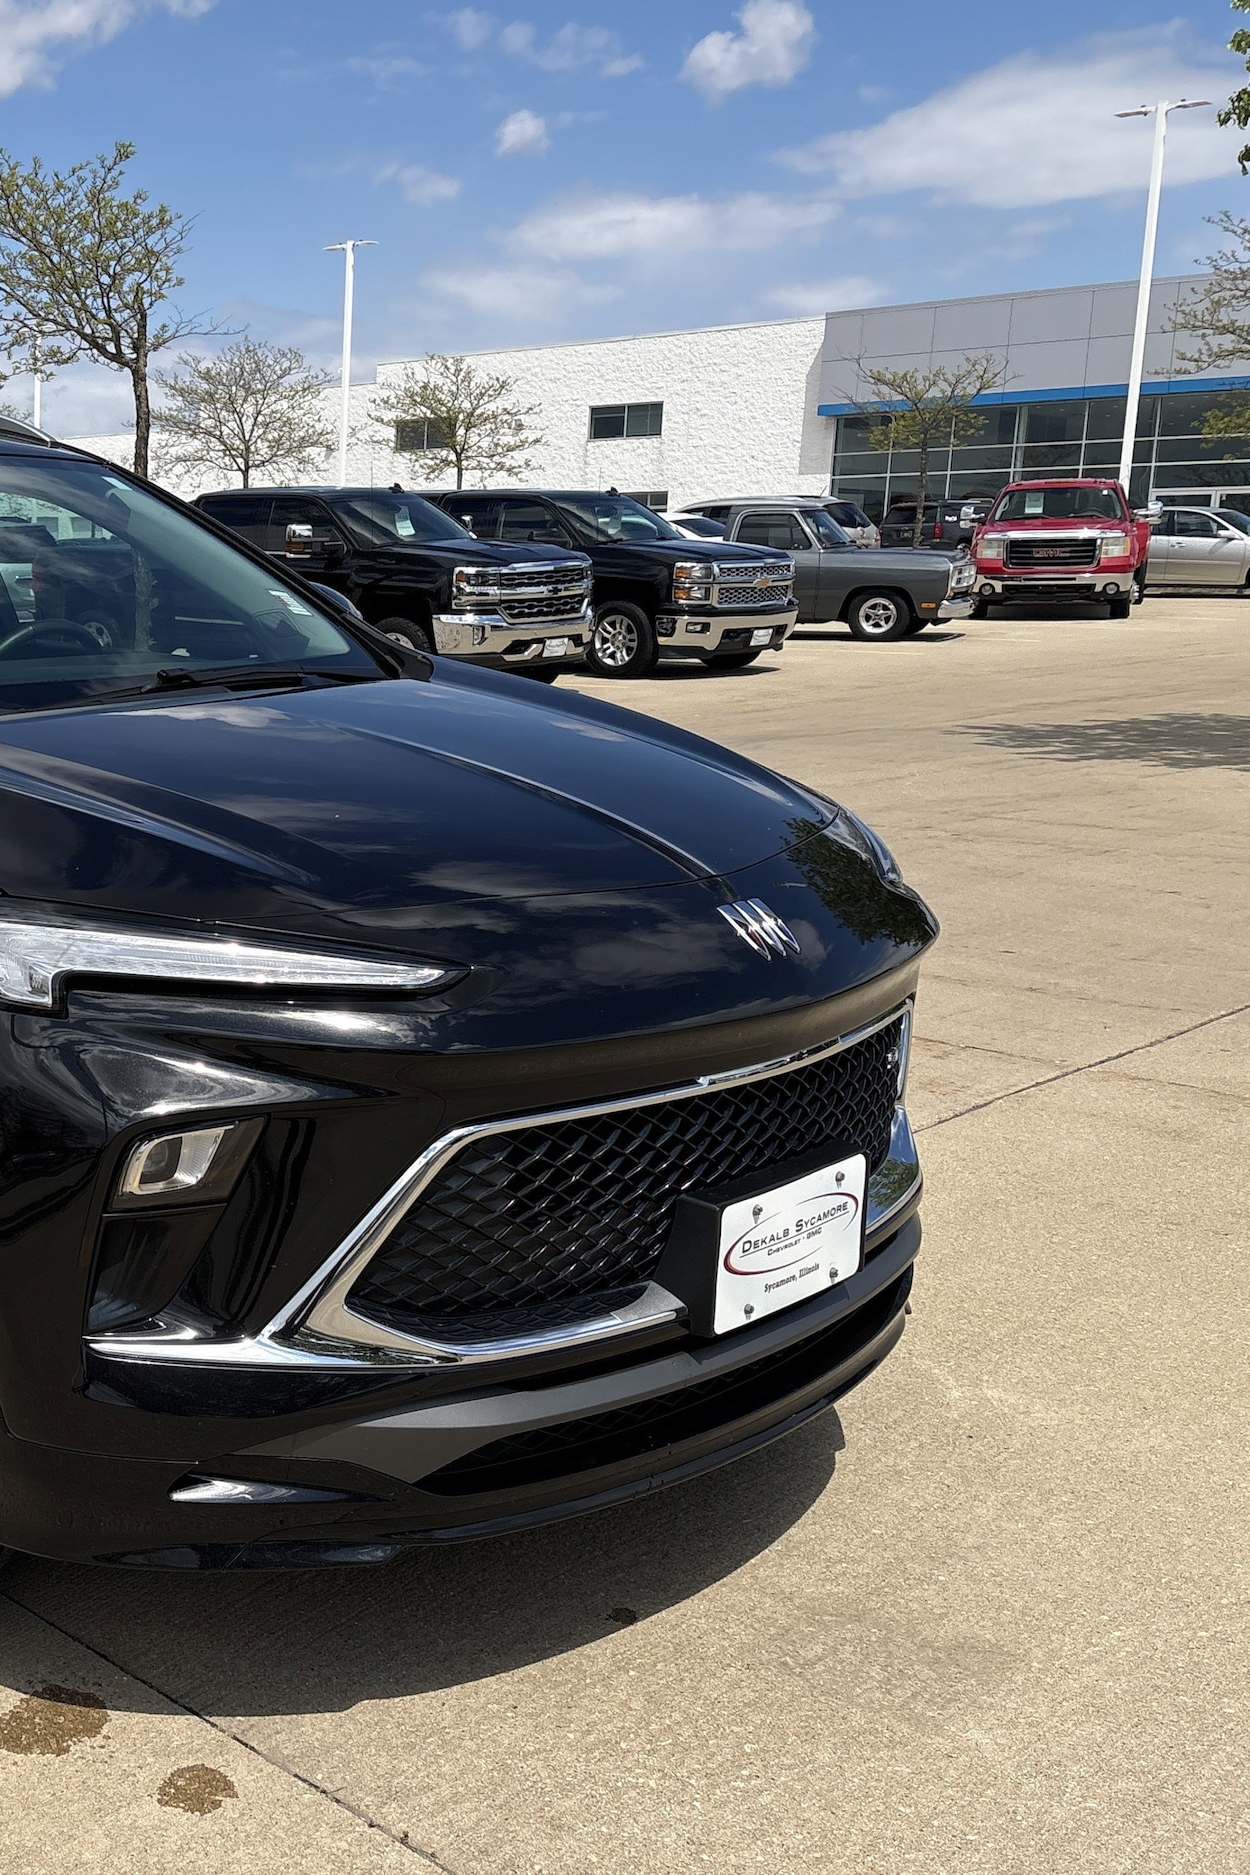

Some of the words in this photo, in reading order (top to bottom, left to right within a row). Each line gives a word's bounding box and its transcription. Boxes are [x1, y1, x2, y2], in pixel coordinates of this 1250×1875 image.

[795, 1201, 848, 1232] SYCAMORE
[806, 1227, 822, 1240] GMC
[764, 1275, 798, 1294] Sycamore,
[798, 1262, 820, 1278] Illinois
